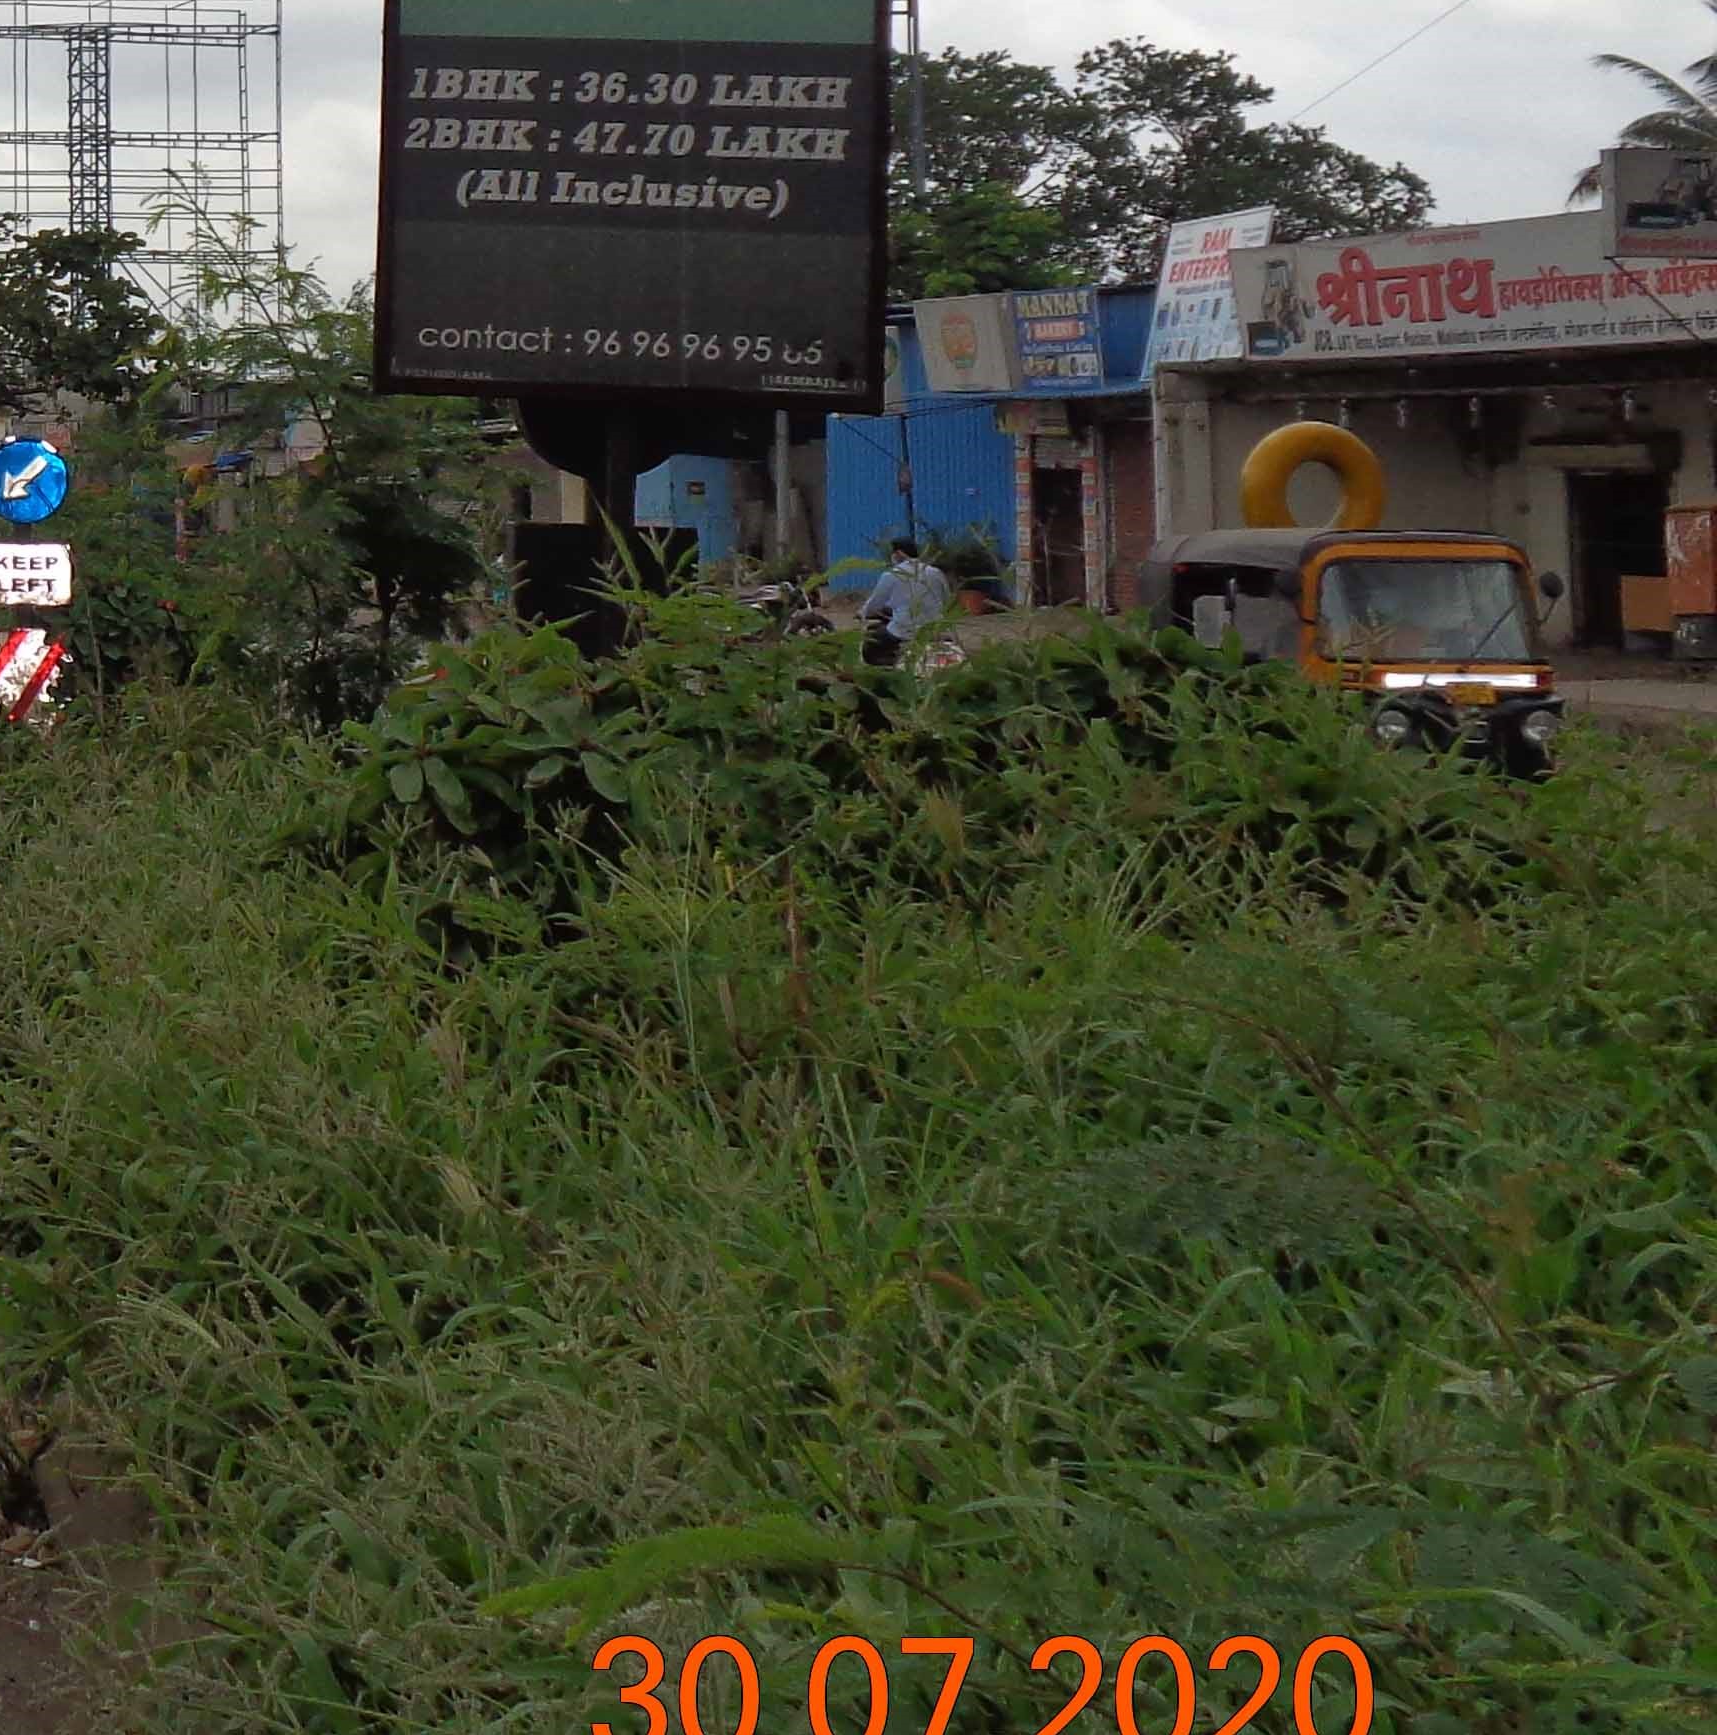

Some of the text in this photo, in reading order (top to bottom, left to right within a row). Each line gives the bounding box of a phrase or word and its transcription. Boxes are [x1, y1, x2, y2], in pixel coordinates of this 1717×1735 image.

[408, 68, 541, 102] 1BHK
[575, 71, 698, 105] 36.30
[708, 75, 852, 109] LAKH
[404, 117, 538, 151] 2BHK
[572, 122, 696, 157] 47.70
[705, 126, 850, 161] LAKH
[455, 169, 790, 219] (All Inclusive)
[1316, 247, 1496, 327] श्रीनाथ
[418, 323, 554, 355] contact
[583, 329, 620, 357] 96
[632, 330, 670, 358] 96
[683, 332, 720, 361] 96
[733, 335, 771, 363] 95
